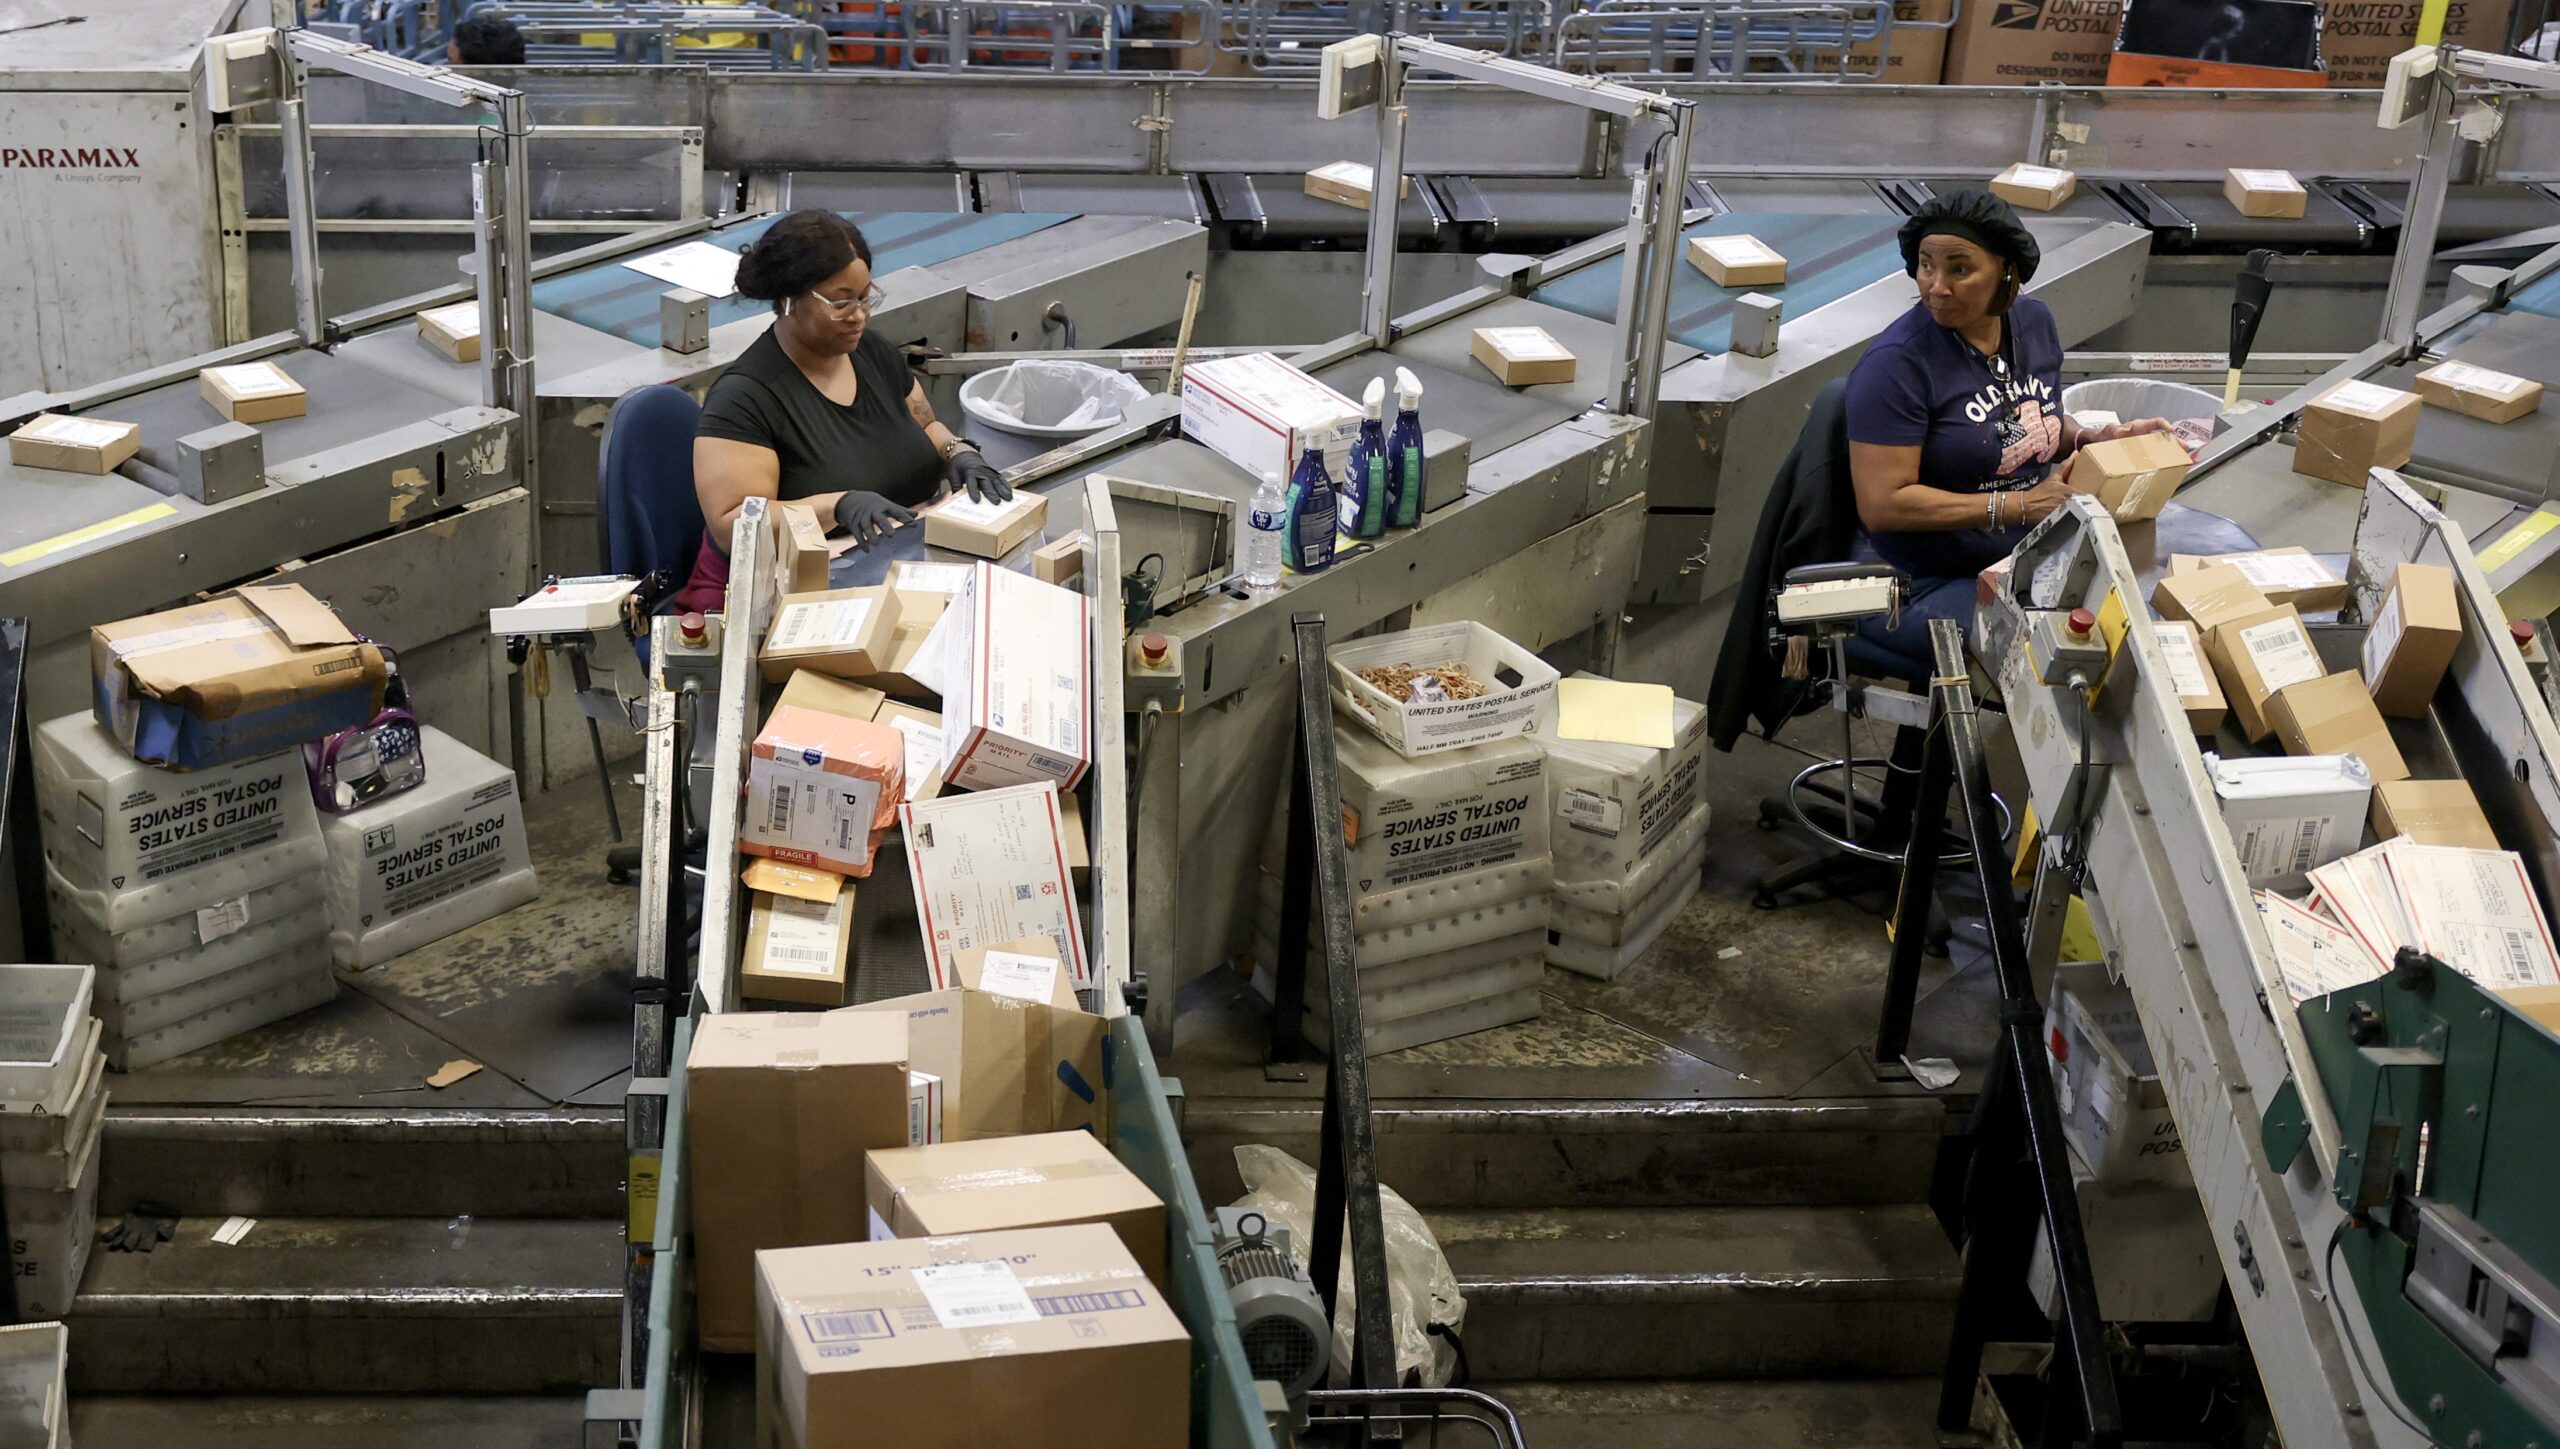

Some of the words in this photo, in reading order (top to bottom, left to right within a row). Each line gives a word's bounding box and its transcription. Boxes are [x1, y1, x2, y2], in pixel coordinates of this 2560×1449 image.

[2050, 0, 2120, 16] UNITED
[2332, 3, 2405, 19] UNITED
[2406, 3, 2468, 18] SES
[2042, 17, 2111, 35] POSTAL
[2323, 21, 2391, 37] POSTAL
[2395, 21, 2468, 37] SECE
[1823, 55, 1879, 66] MUTIPLE
[2052, 52, 2069, 62] DO
[2072, 52, 2098, 64] NOT
[2331, 55, 2349, 66] DO
[2352, 56, 2378, 67] NOT
[1996, 64, 2059, 78] DESIGNED
[2060, 66, 2086, 79] FOR
[2, 148, 140, 168] PARAMAX
[55, 174, 62, 182] A
[97, 174, 142, 184] Company
[1965, 384, 2003, 423] OLD
[1408, 706, 1445, 717] UNITED
[1446, 701, 1482, 714] STATES
[1483, 693, 1518, 708] POSTAL
[1519, 681, 1553, 699] SERVICE
[1467, 709, 1499, 719] WARNING
[983, 740, 1023, 757] PRIORITY
[1416, 744, 1434, 752] HALF
[1448, 739, 1465, 747] TRAY
[990, 749, 1011, 759] MAIL
[1674, 750, 1701, 787] POSTAL
[212, 774, 282, 807] POSTAL
[1670, 771, 1697, 806] UNITED
[842, 793, 856, 805] P
[1435, 799, 1453, 809] ONLY
[1468, 794, 1483, 804] FOR
[1639, 778, 1671, 820] SERVICE
[129, 797, 207, 834] SERVICE
[213, 797, 277, 828] UNITED
[1463, 794, 1529, 821] POSTAL
[1383, 810, 1458, 839] SERVICE
[1641, 798, 1670, 835] STATES
[139, 817, 209, 851] STATES
[447, 814, 505, 848] POSTAL
[1460, 816, 1520, 842] UNITED
[448, 834, 500, 866] UNITED
[1390, 830, 1456, 857] STATES
[200, 851, 217, 862] FOR
[377, 838, 443, 876] SERVICE
[775, 850, 812, 860] FRAGILE
[1481, 852, 1516, 866] WARNING
[1441, 864, 1458, 874] FOR
[1459, 860, 1475, 870] NOT
[385, 858, 444, 891] STATES
[1392, 875, 1408, 886] USE
[1409, 868, 1441, 881] PRIVATE
[950, 893, 961, 926] PRIORITY
[862, 1265, 902, 1277] 15"
